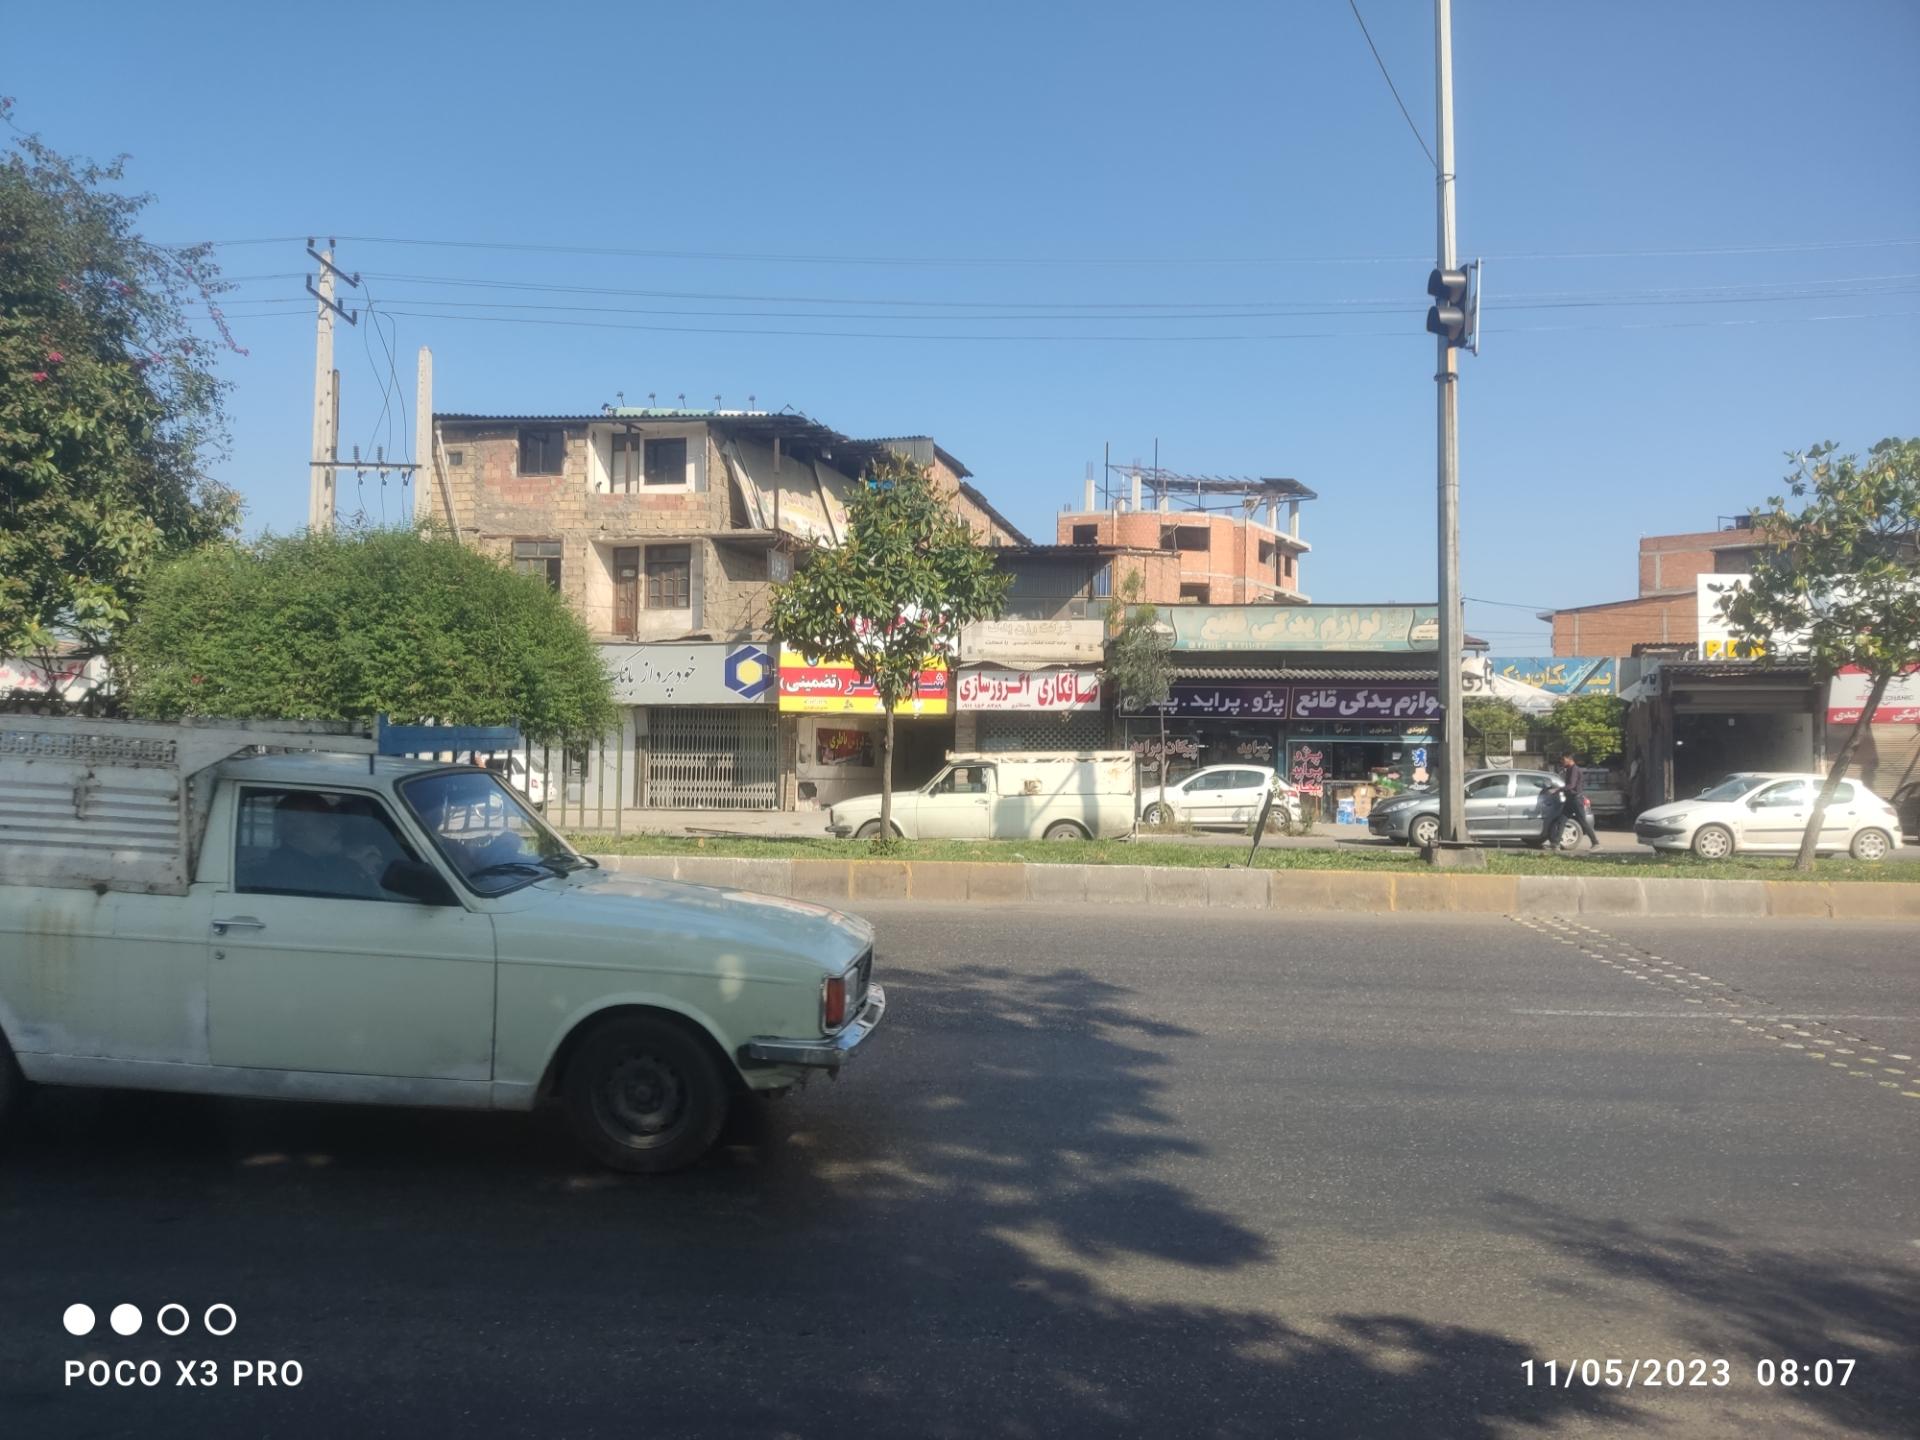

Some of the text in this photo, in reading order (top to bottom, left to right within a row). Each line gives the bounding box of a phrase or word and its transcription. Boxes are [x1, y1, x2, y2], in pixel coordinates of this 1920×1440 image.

[640, 655, 697, 698] خودپرداز
[1037, 672, 1099, 706] صافکاری
[1190, 691, 1241, 715] پراید
[1251, 690, 1286, 716] پژو
[1295, 689, 1441, 717] وازم یدکی قانع
[1294, 745, 1323, 766] پژو
